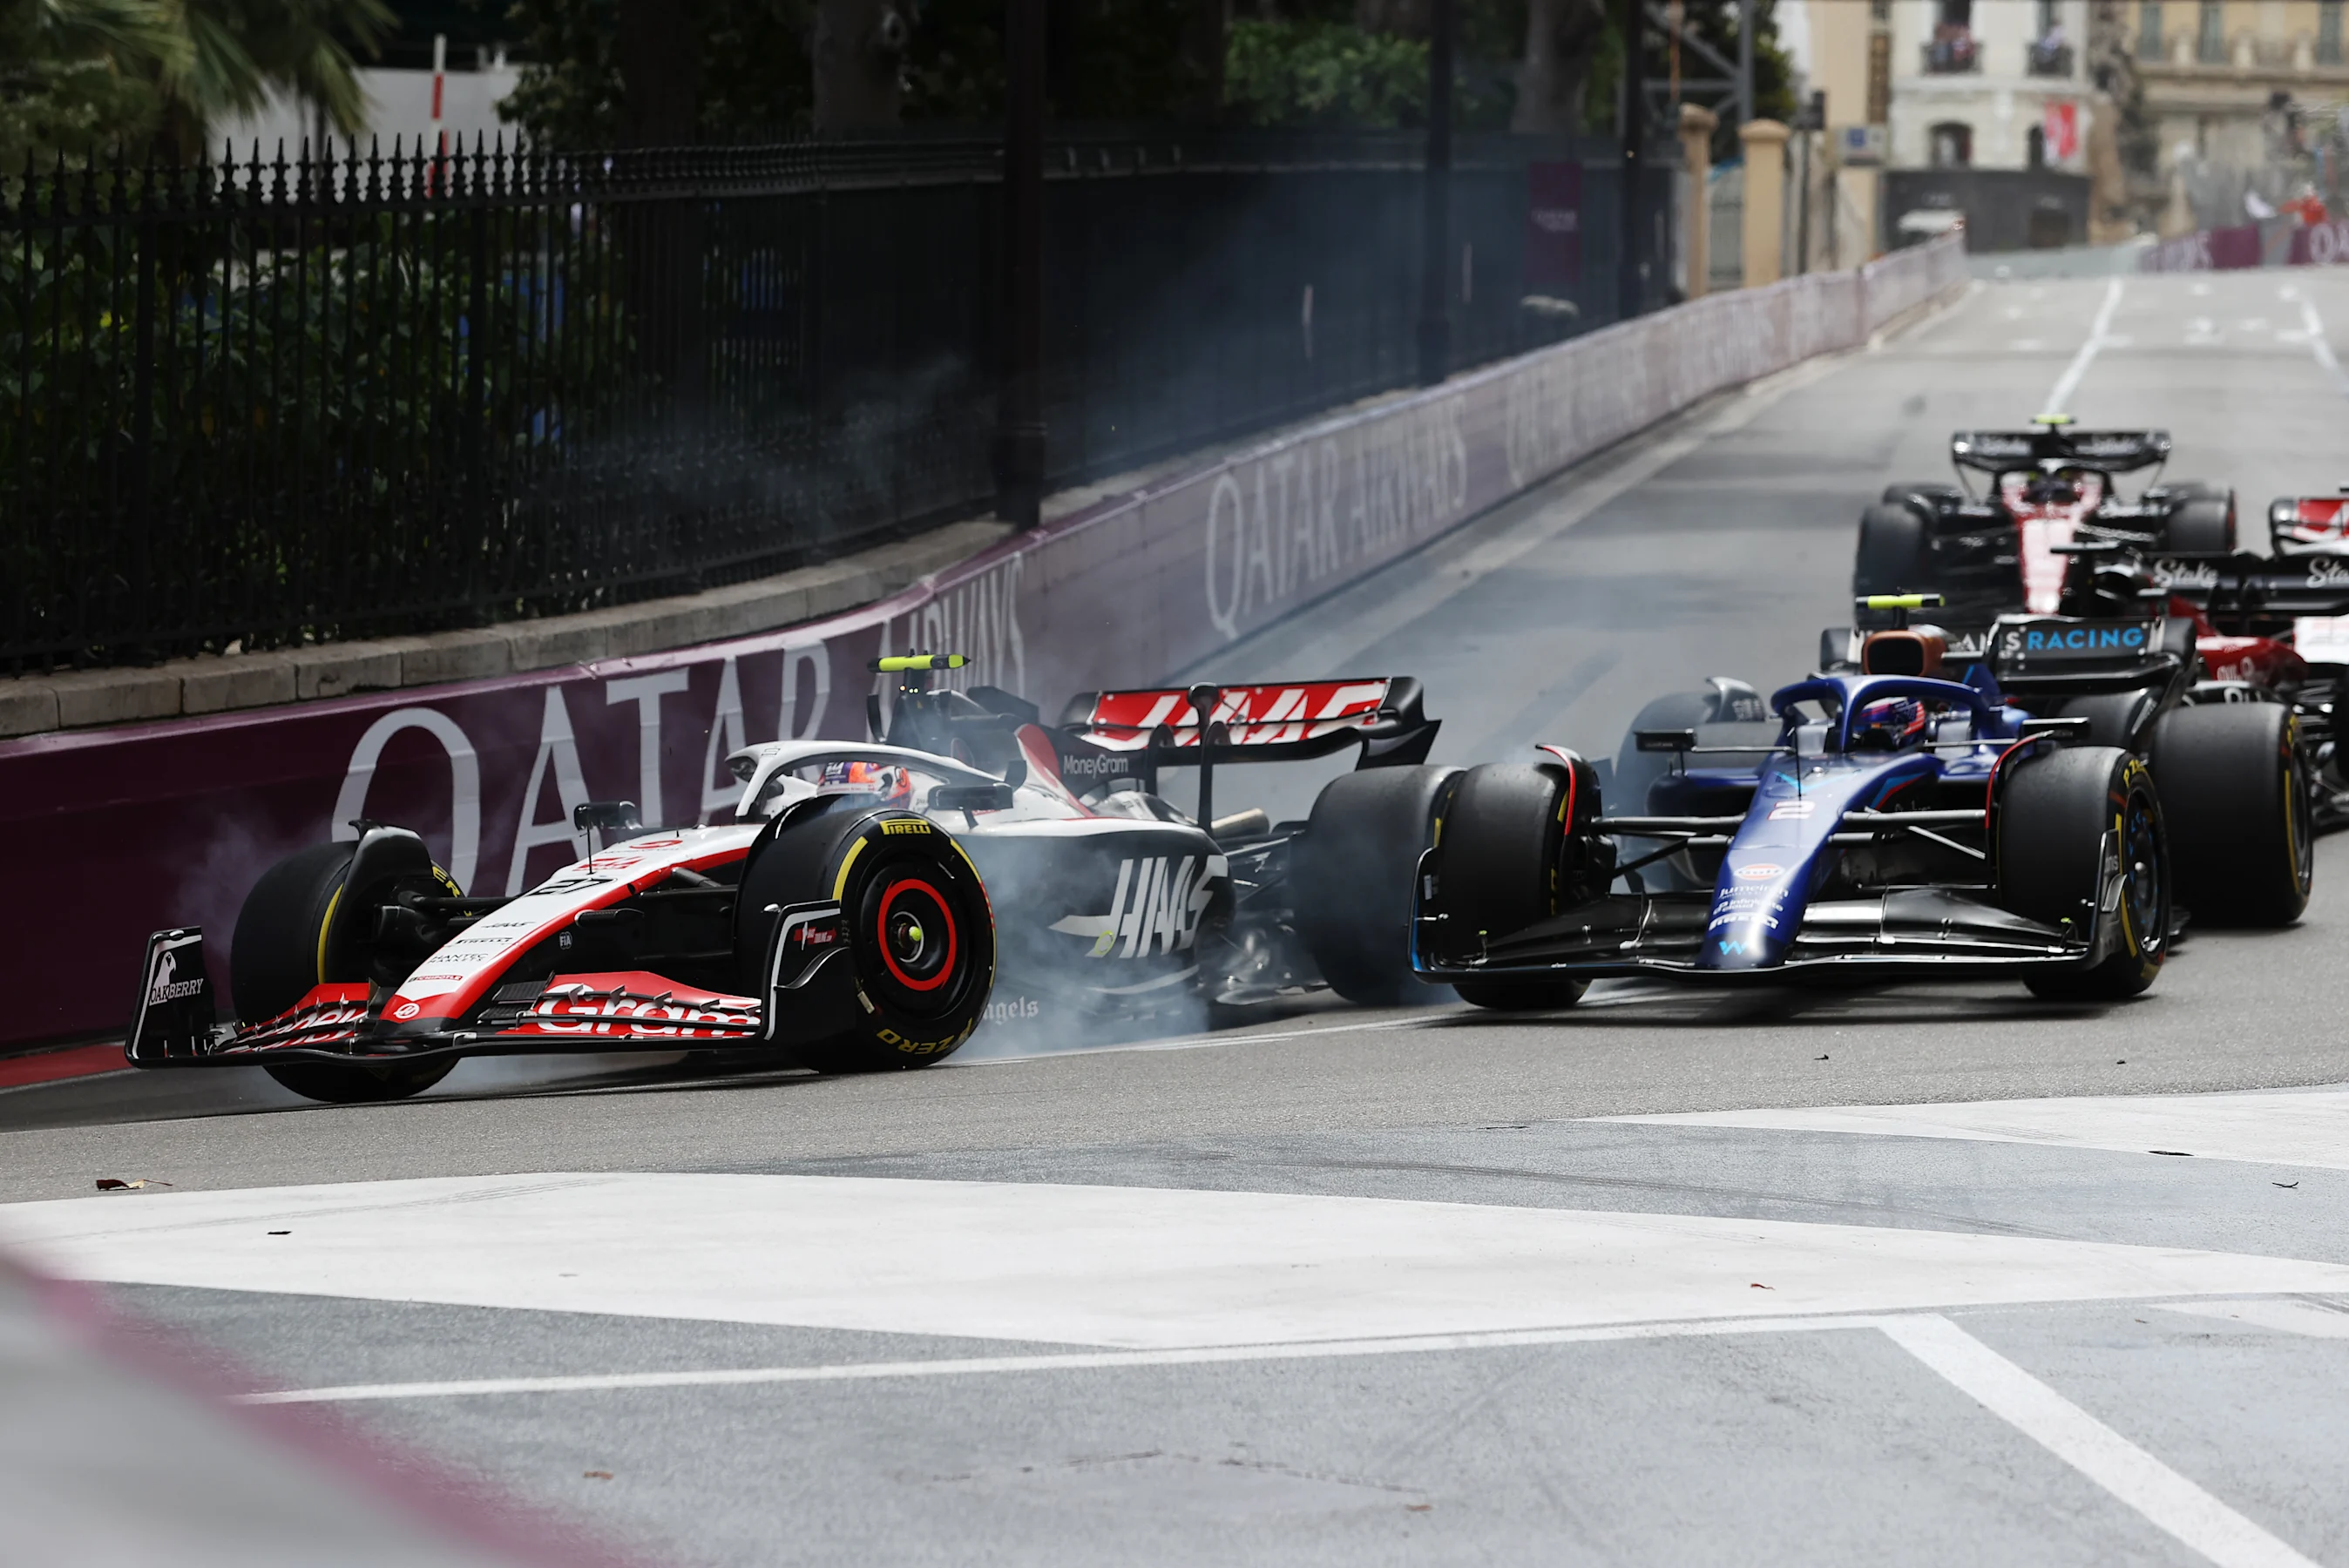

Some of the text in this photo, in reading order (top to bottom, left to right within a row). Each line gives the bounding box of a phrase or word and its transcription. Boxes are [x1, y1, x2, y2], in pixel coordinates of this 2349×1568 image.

[1206, 436, 1339, 641] QATAR
[2154, 557, 2219, 588] Stake
[2027, 626, 2144, 651] RACING
[333, 639, 829, 898] QATAR
[1063, 753, 1129, 779] MoneyGram
[1767, 801, 1816, 821] 2
[880, 819, 931, 835] PIRELLI
[523, 878, 617, 897] 27
[1048, 853, 1229, 959] HAAS
[560, 934, 571, 947] FIA
[151, 978, 204, 1004] OAKBERRY
[876, 1028, 955, 1055] ZERO
